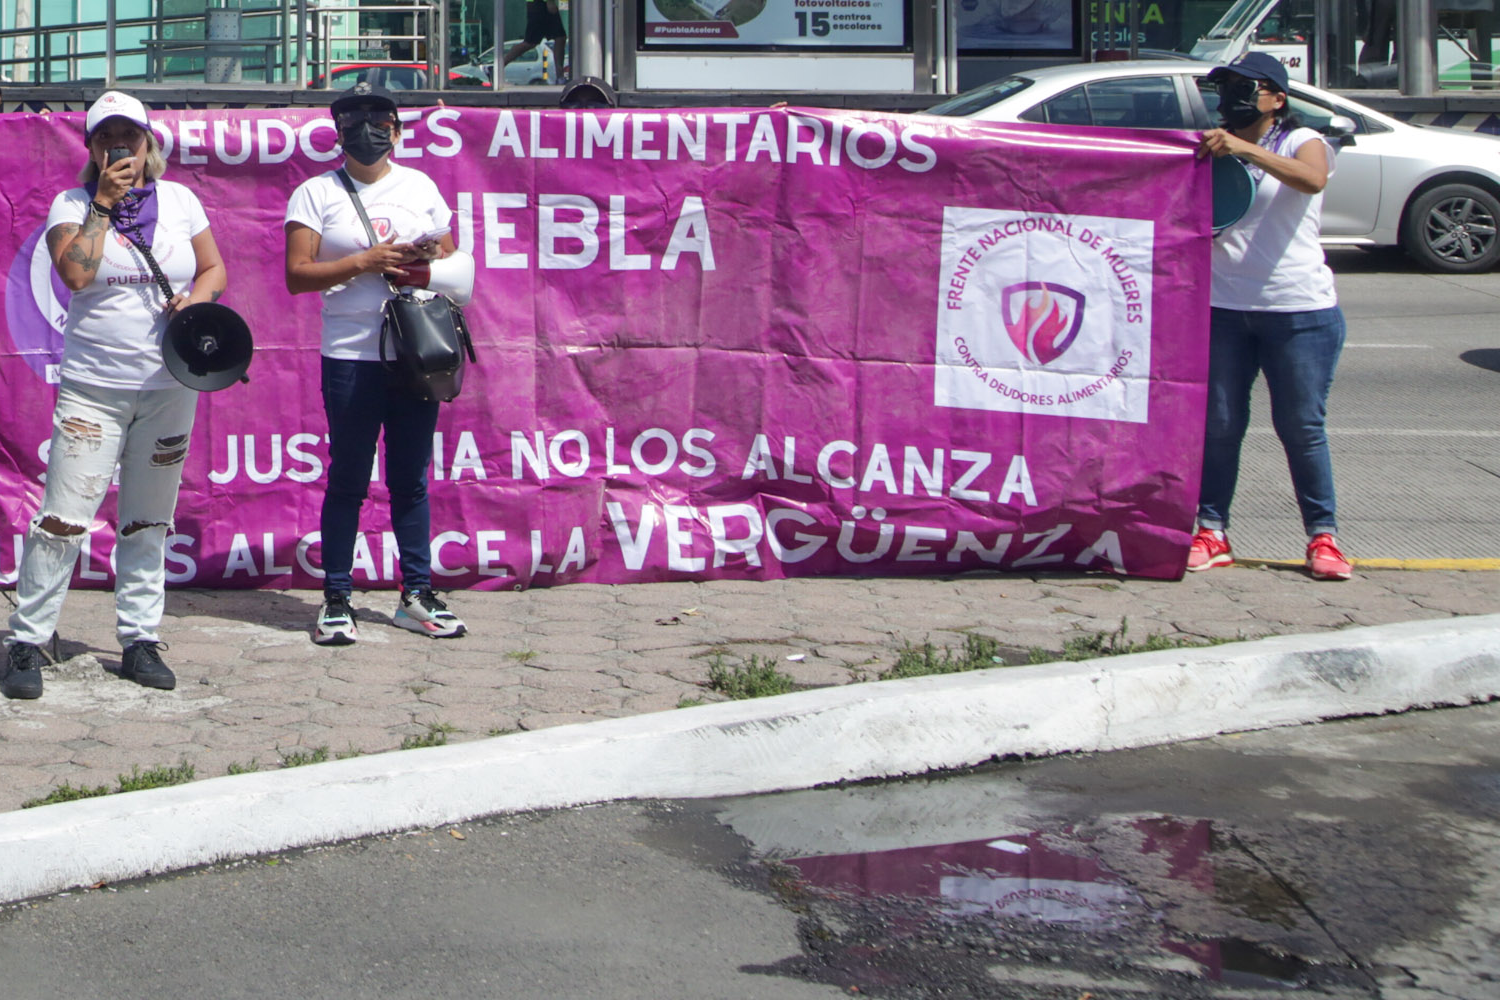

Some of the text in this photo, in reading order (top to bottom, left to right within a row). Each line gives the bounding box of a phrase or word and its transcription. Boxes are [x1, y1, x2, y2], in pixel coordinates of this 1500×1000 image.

[794, 11, 831, 37] 15
[832, 13, 872, 21] centros
[832, 22, 882, 30] escolares
[487, 111, 939, 173] ALIMENTARIOS
[947, 217, 1143, 324] FRENTE NACIONAL DE MUJERES
[954, 336, 1133, 406] CONTRA DEUDORES ALIMENTARIOS
[510, 427, 1040, 507] NO LOS ALCANZA
[531, 526, 587, 575] LA
[605, 500, 1128, 576] VERGÜENZA
